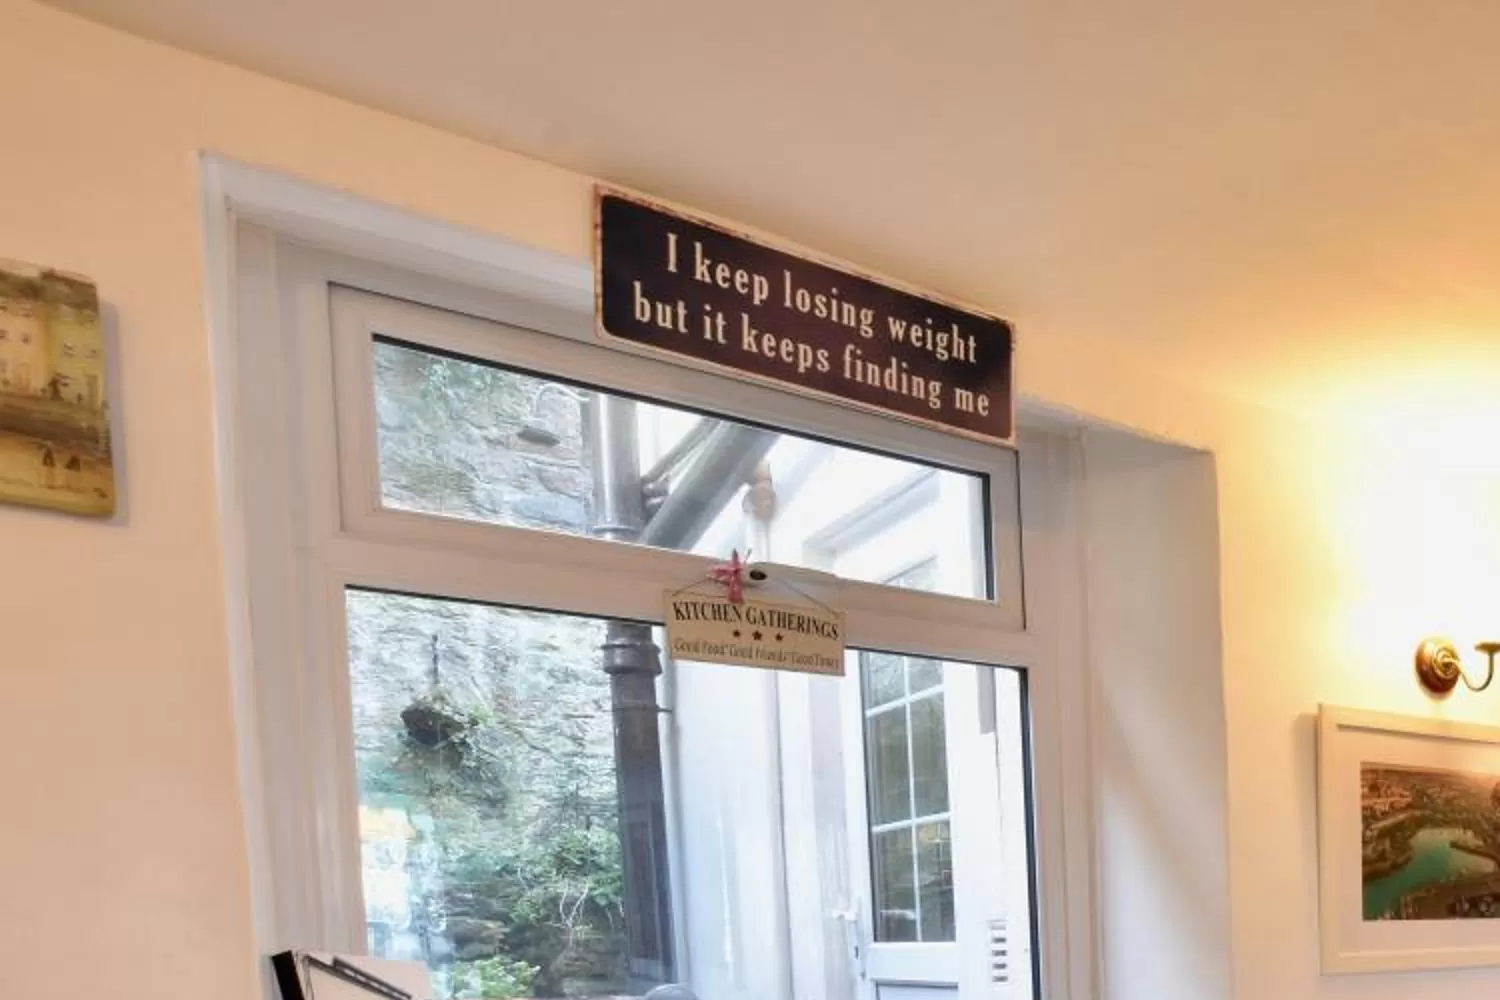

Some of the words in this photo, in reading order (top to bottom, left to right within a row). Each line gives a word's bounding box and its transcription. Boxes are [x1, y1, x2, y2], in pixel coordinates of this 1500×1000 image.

[632, 280, 689, 334] but
[703, 303, 728, 345] it
[741, 312, 831, 374] keeps
[843, 343, 943, 410] finding
[953, 386, 990, 417] me
[666, 231, 678, 273] I
[693, 240, 770, 306] keep
[783, 269, 876, 338] losing
[887, 317, 978, 365] weight
[672, 601, 745, 623] KITCHEN
[745, 606, 840, 641] GATHERINGS
